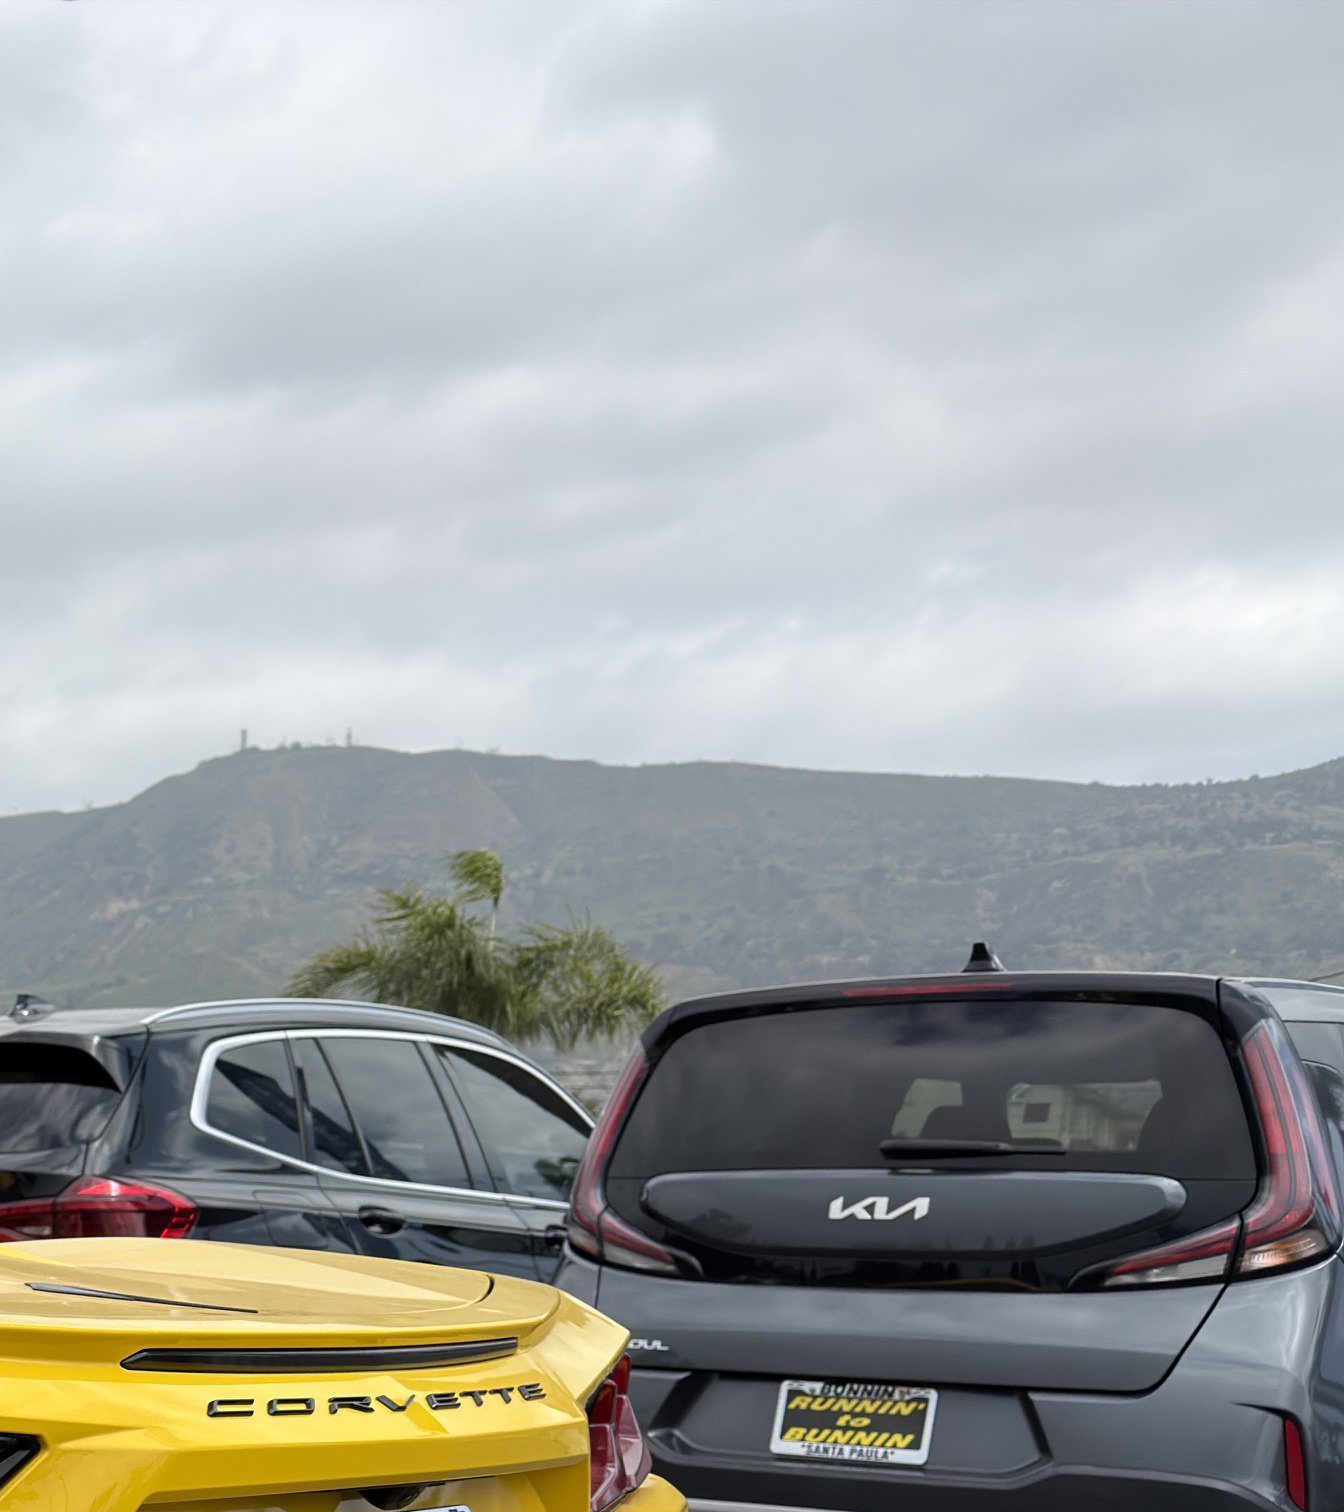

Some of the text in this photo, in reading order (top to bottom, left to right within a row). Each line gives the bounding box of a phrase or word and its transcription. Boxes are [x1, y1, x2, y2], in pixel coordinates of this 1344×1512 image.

[828, 1196, 931, 1220] KIA
[206, 1382, 547, 1418] CORVETTE
[821, 1383, 896, 1399] BUNNIN
[788, 1395, 927, 1416] RUNNIN'
[835, 1413, 872, 1428] to
[781, 1427, 916, 1450] BUNNIN
